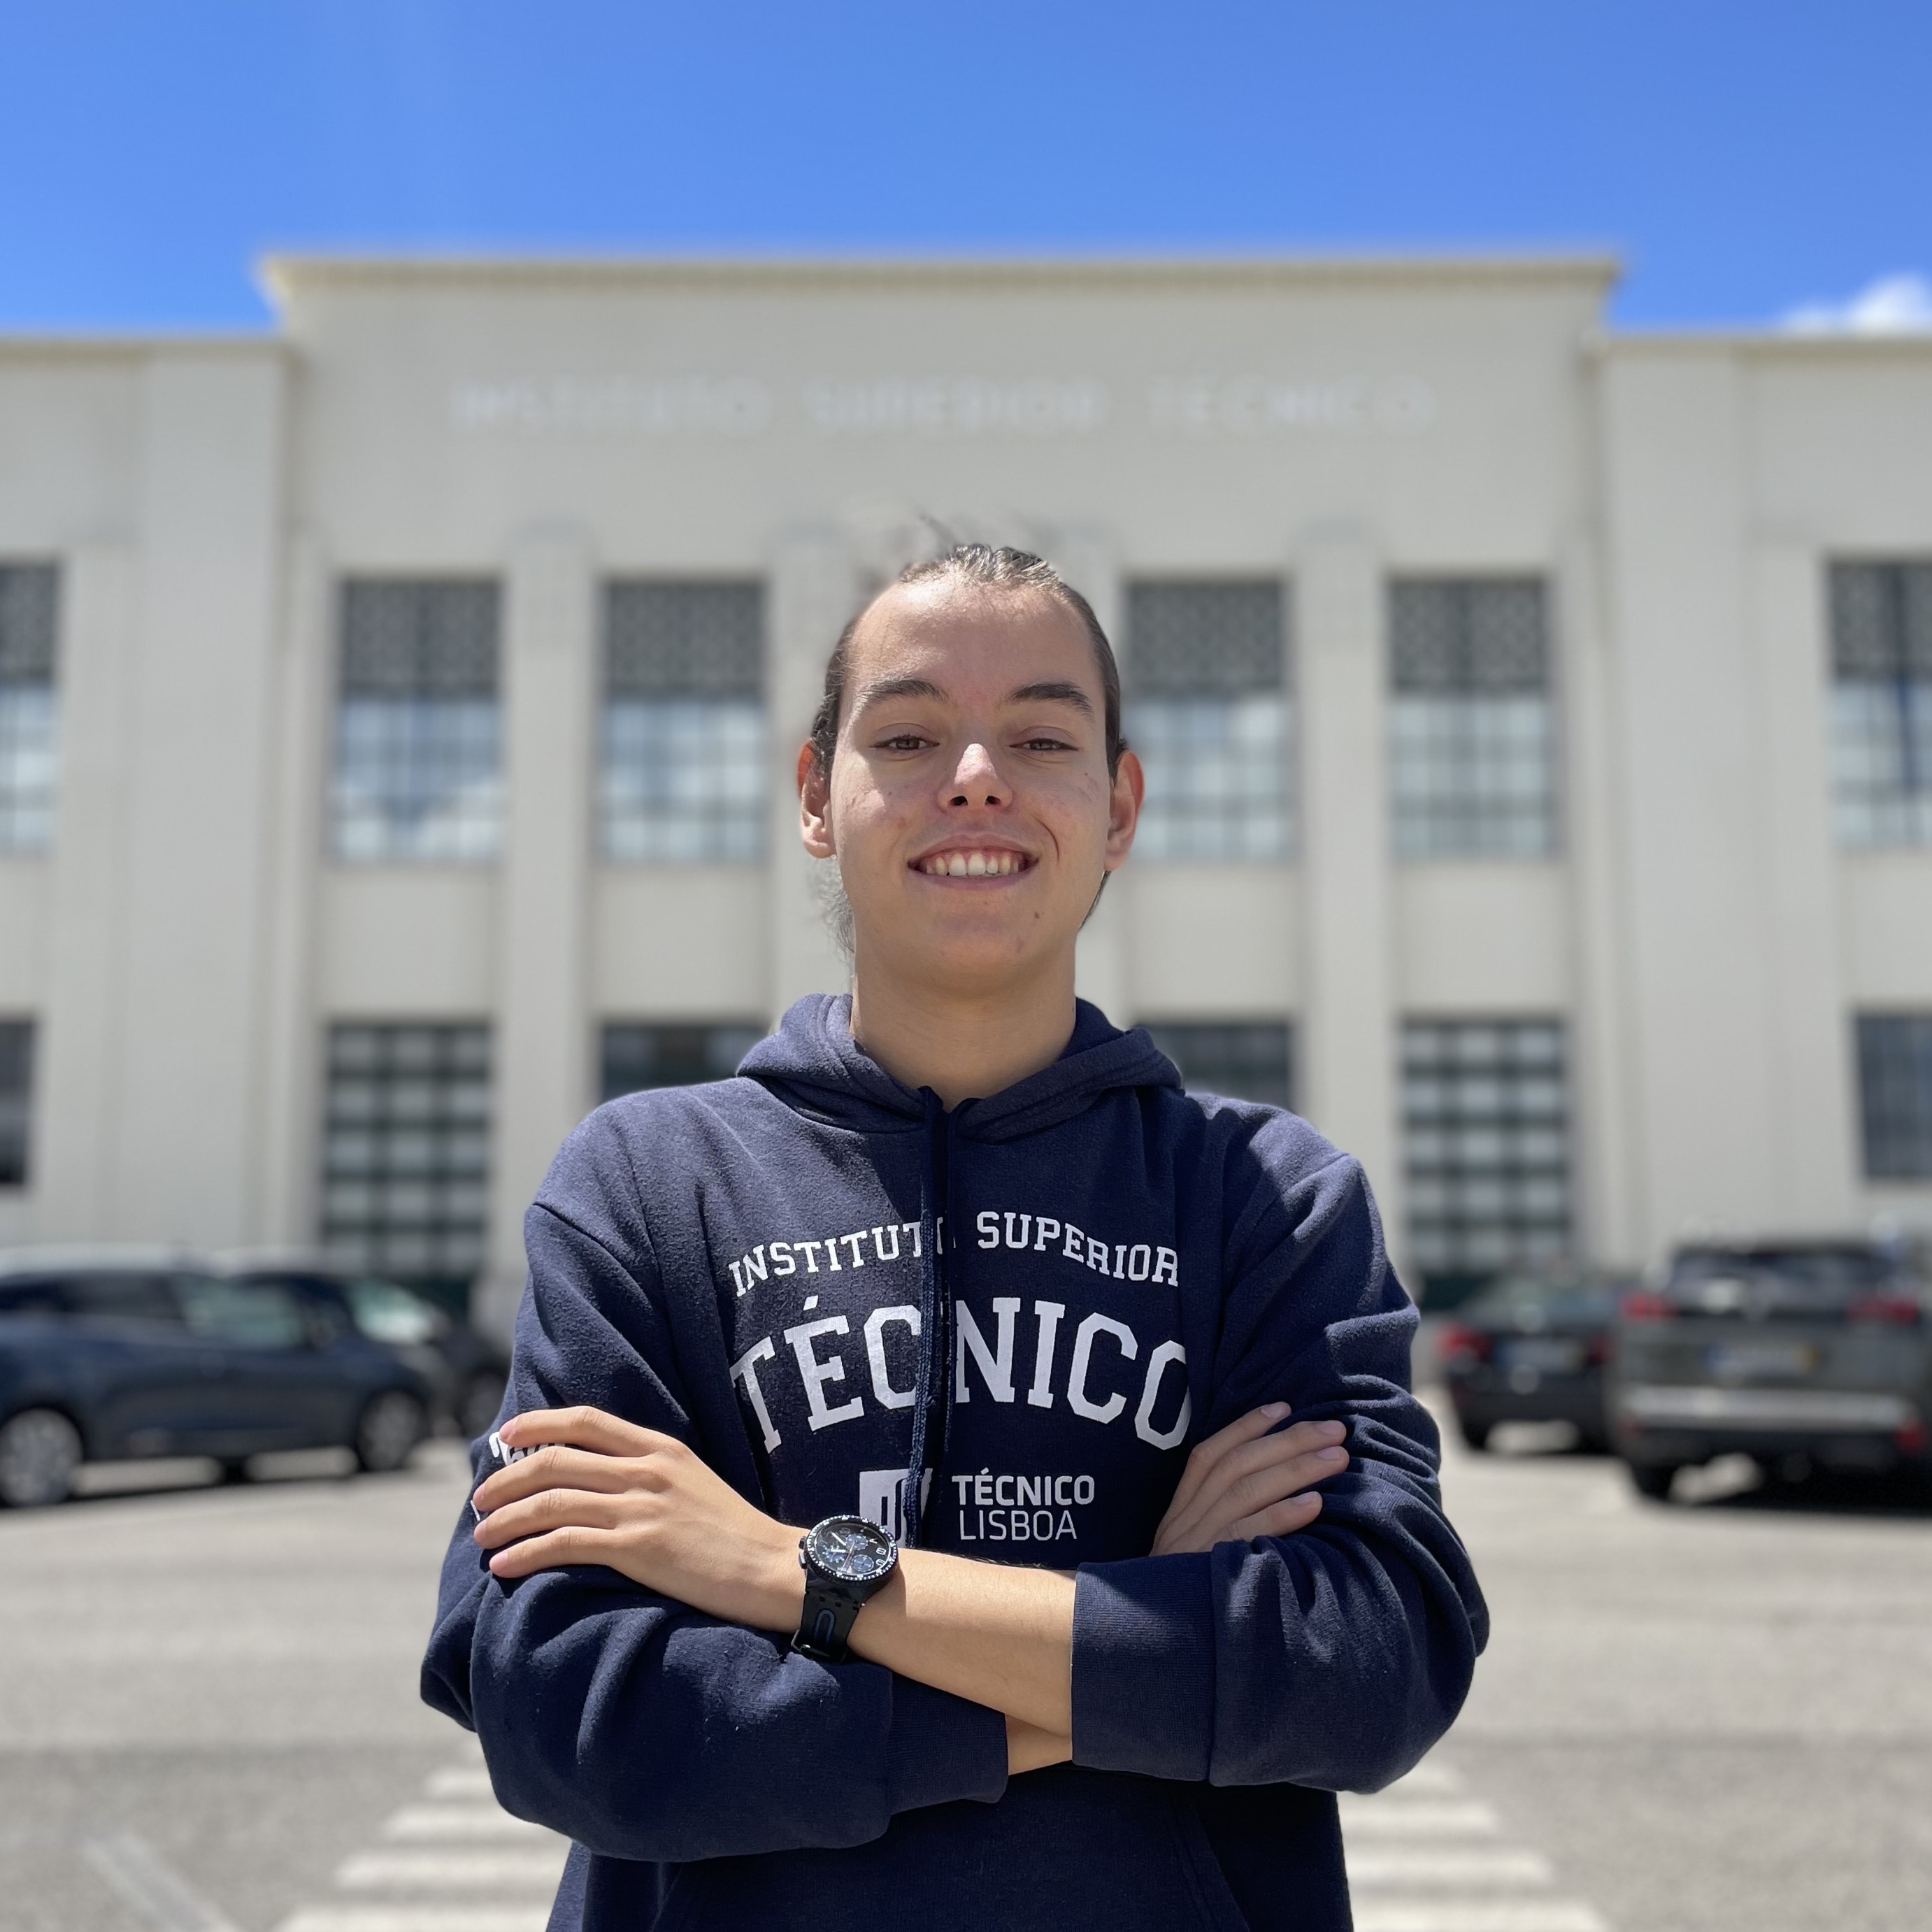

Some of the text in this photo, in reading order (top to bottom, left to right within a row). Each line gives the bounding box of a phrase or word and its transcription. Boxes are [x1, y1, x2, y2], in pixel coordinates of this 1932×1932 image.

[977, 1211, 1179, 1287] SUPERIOR
[729, 1296, 1192, 1454] TÉCNICO
[952, 1467, 1095, 1505] TÉCNICO
[959, 1510, 1077, 1541] LISBOA
